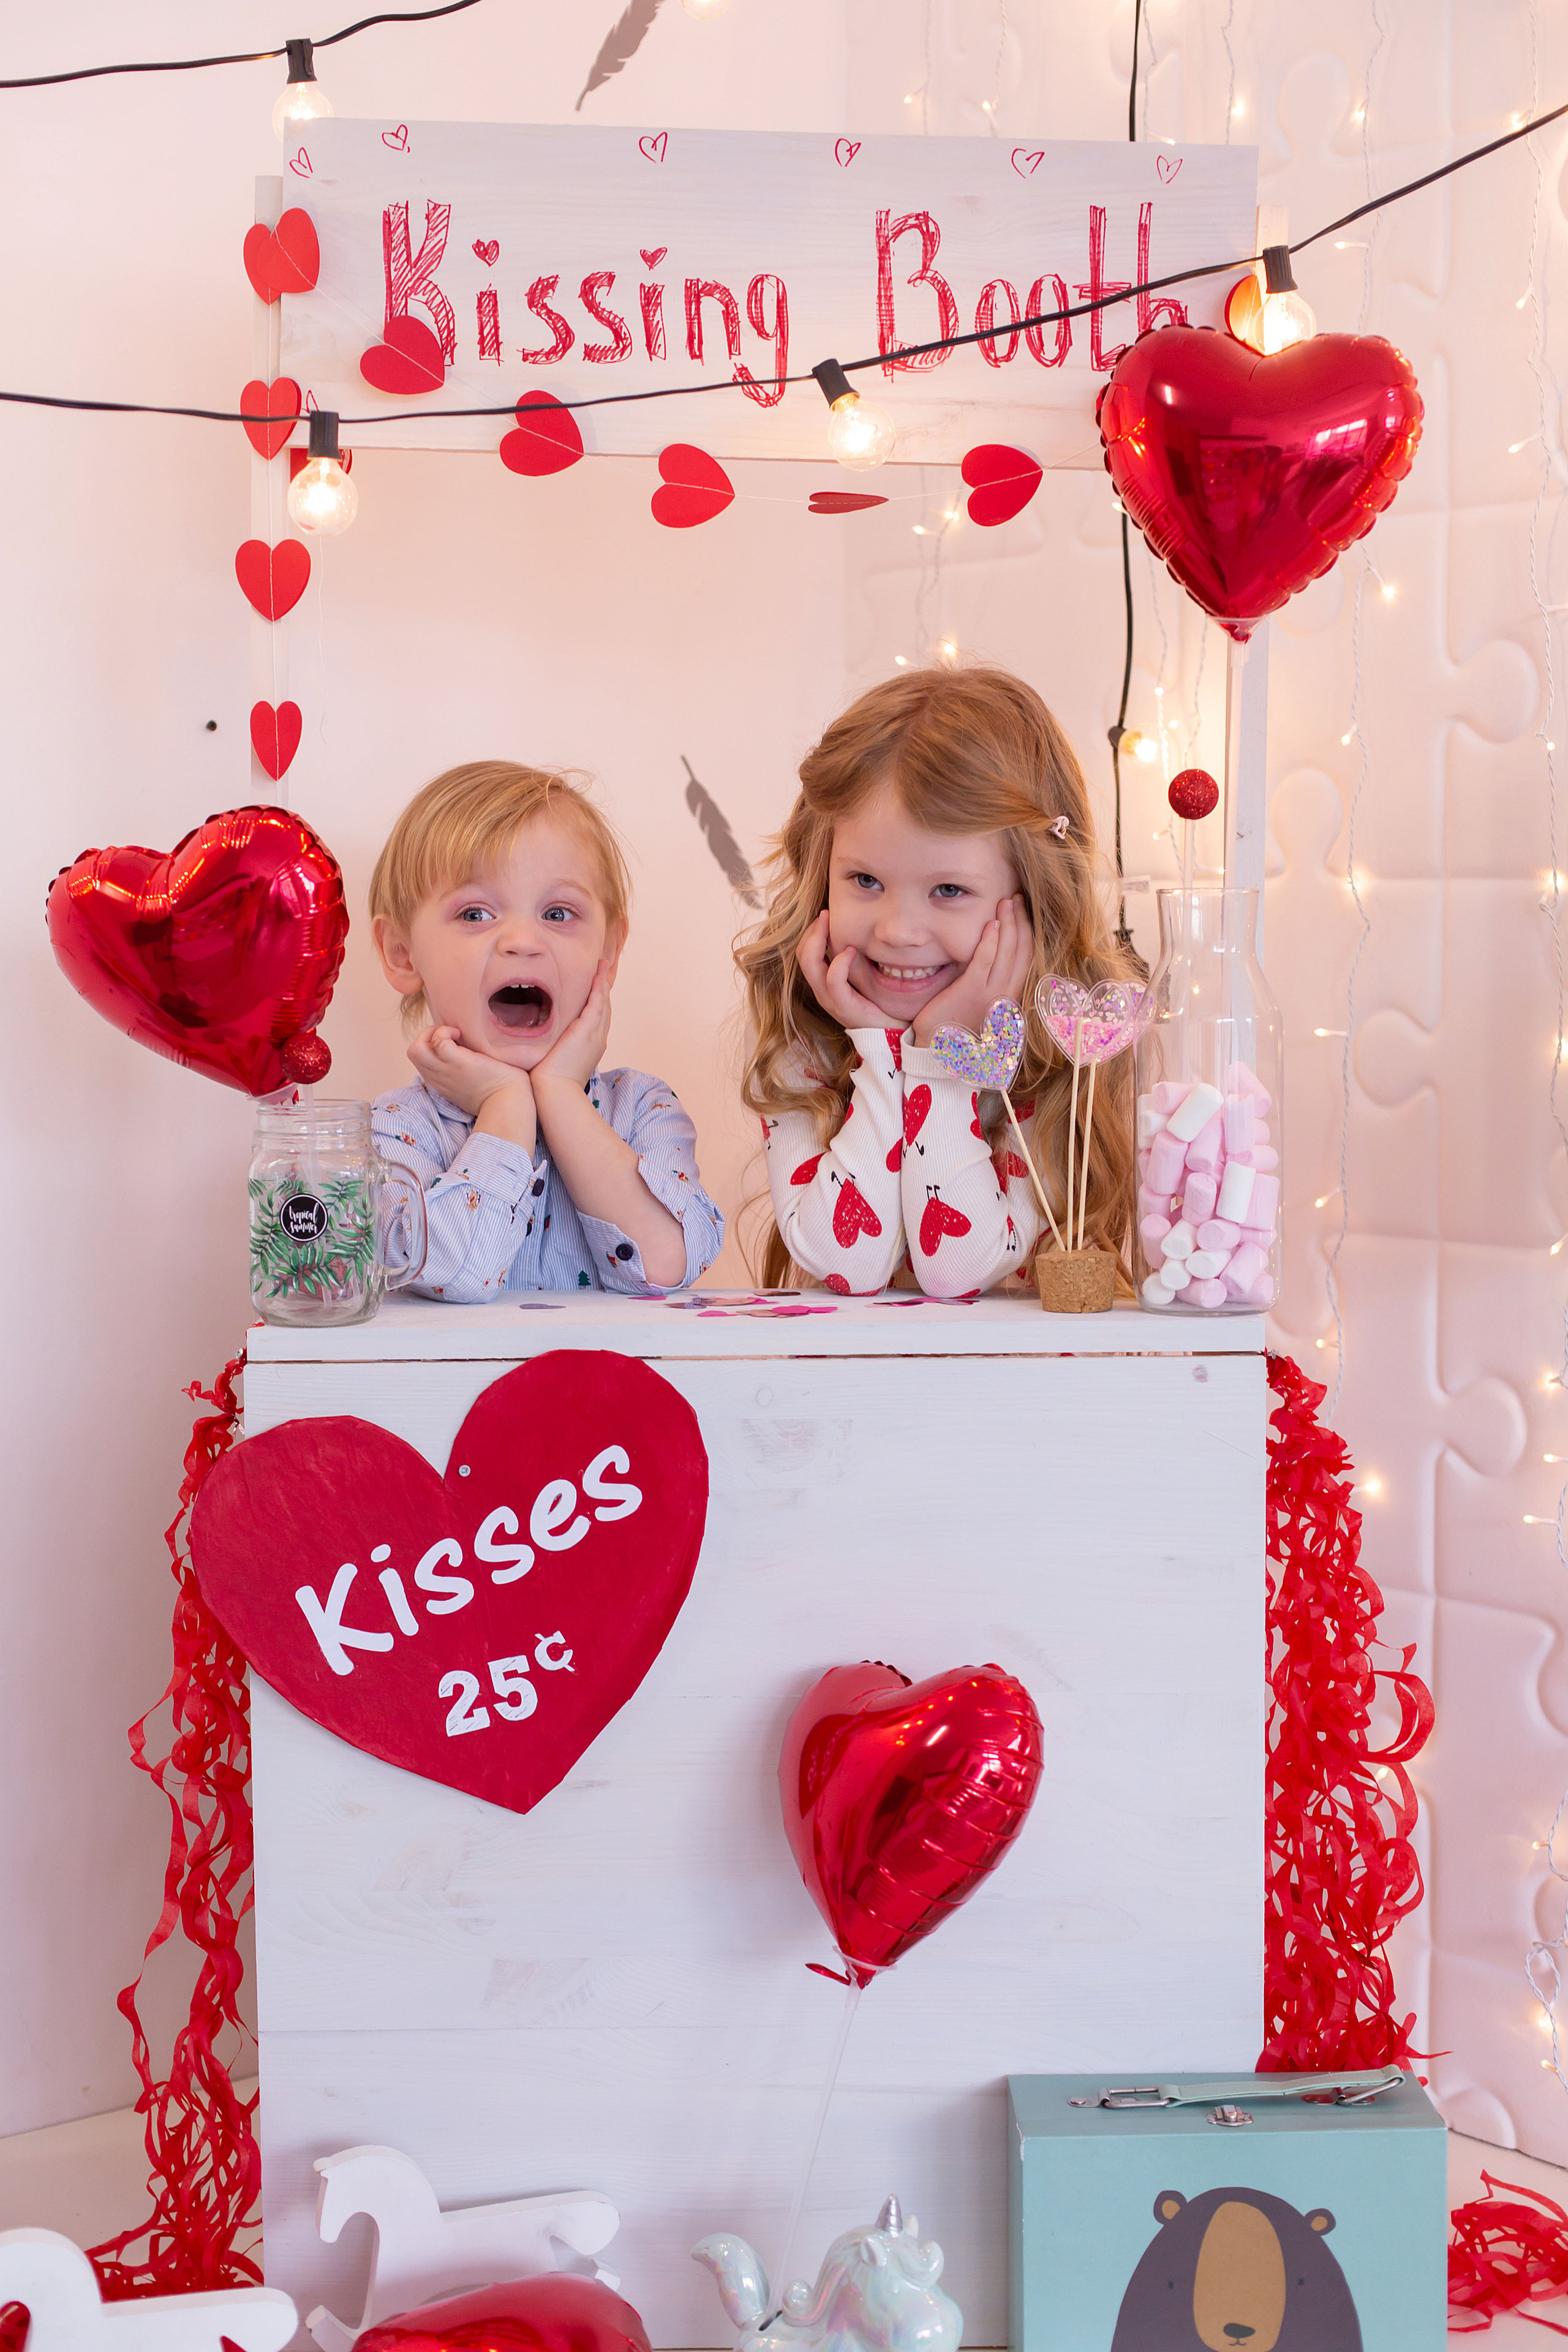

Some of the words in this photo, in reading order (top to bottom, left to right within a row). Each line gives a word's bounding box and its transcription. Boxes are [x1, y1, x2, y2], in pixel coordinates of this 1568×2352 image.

[382, 199, 790, 409] Kissing
[288, 1202, 318, 1224] tropical
[288, 1221, 318, 1234] summer
[295, 1445, 643, 1676] Kisses
[438, 1630, 575, 1737] 25¢
